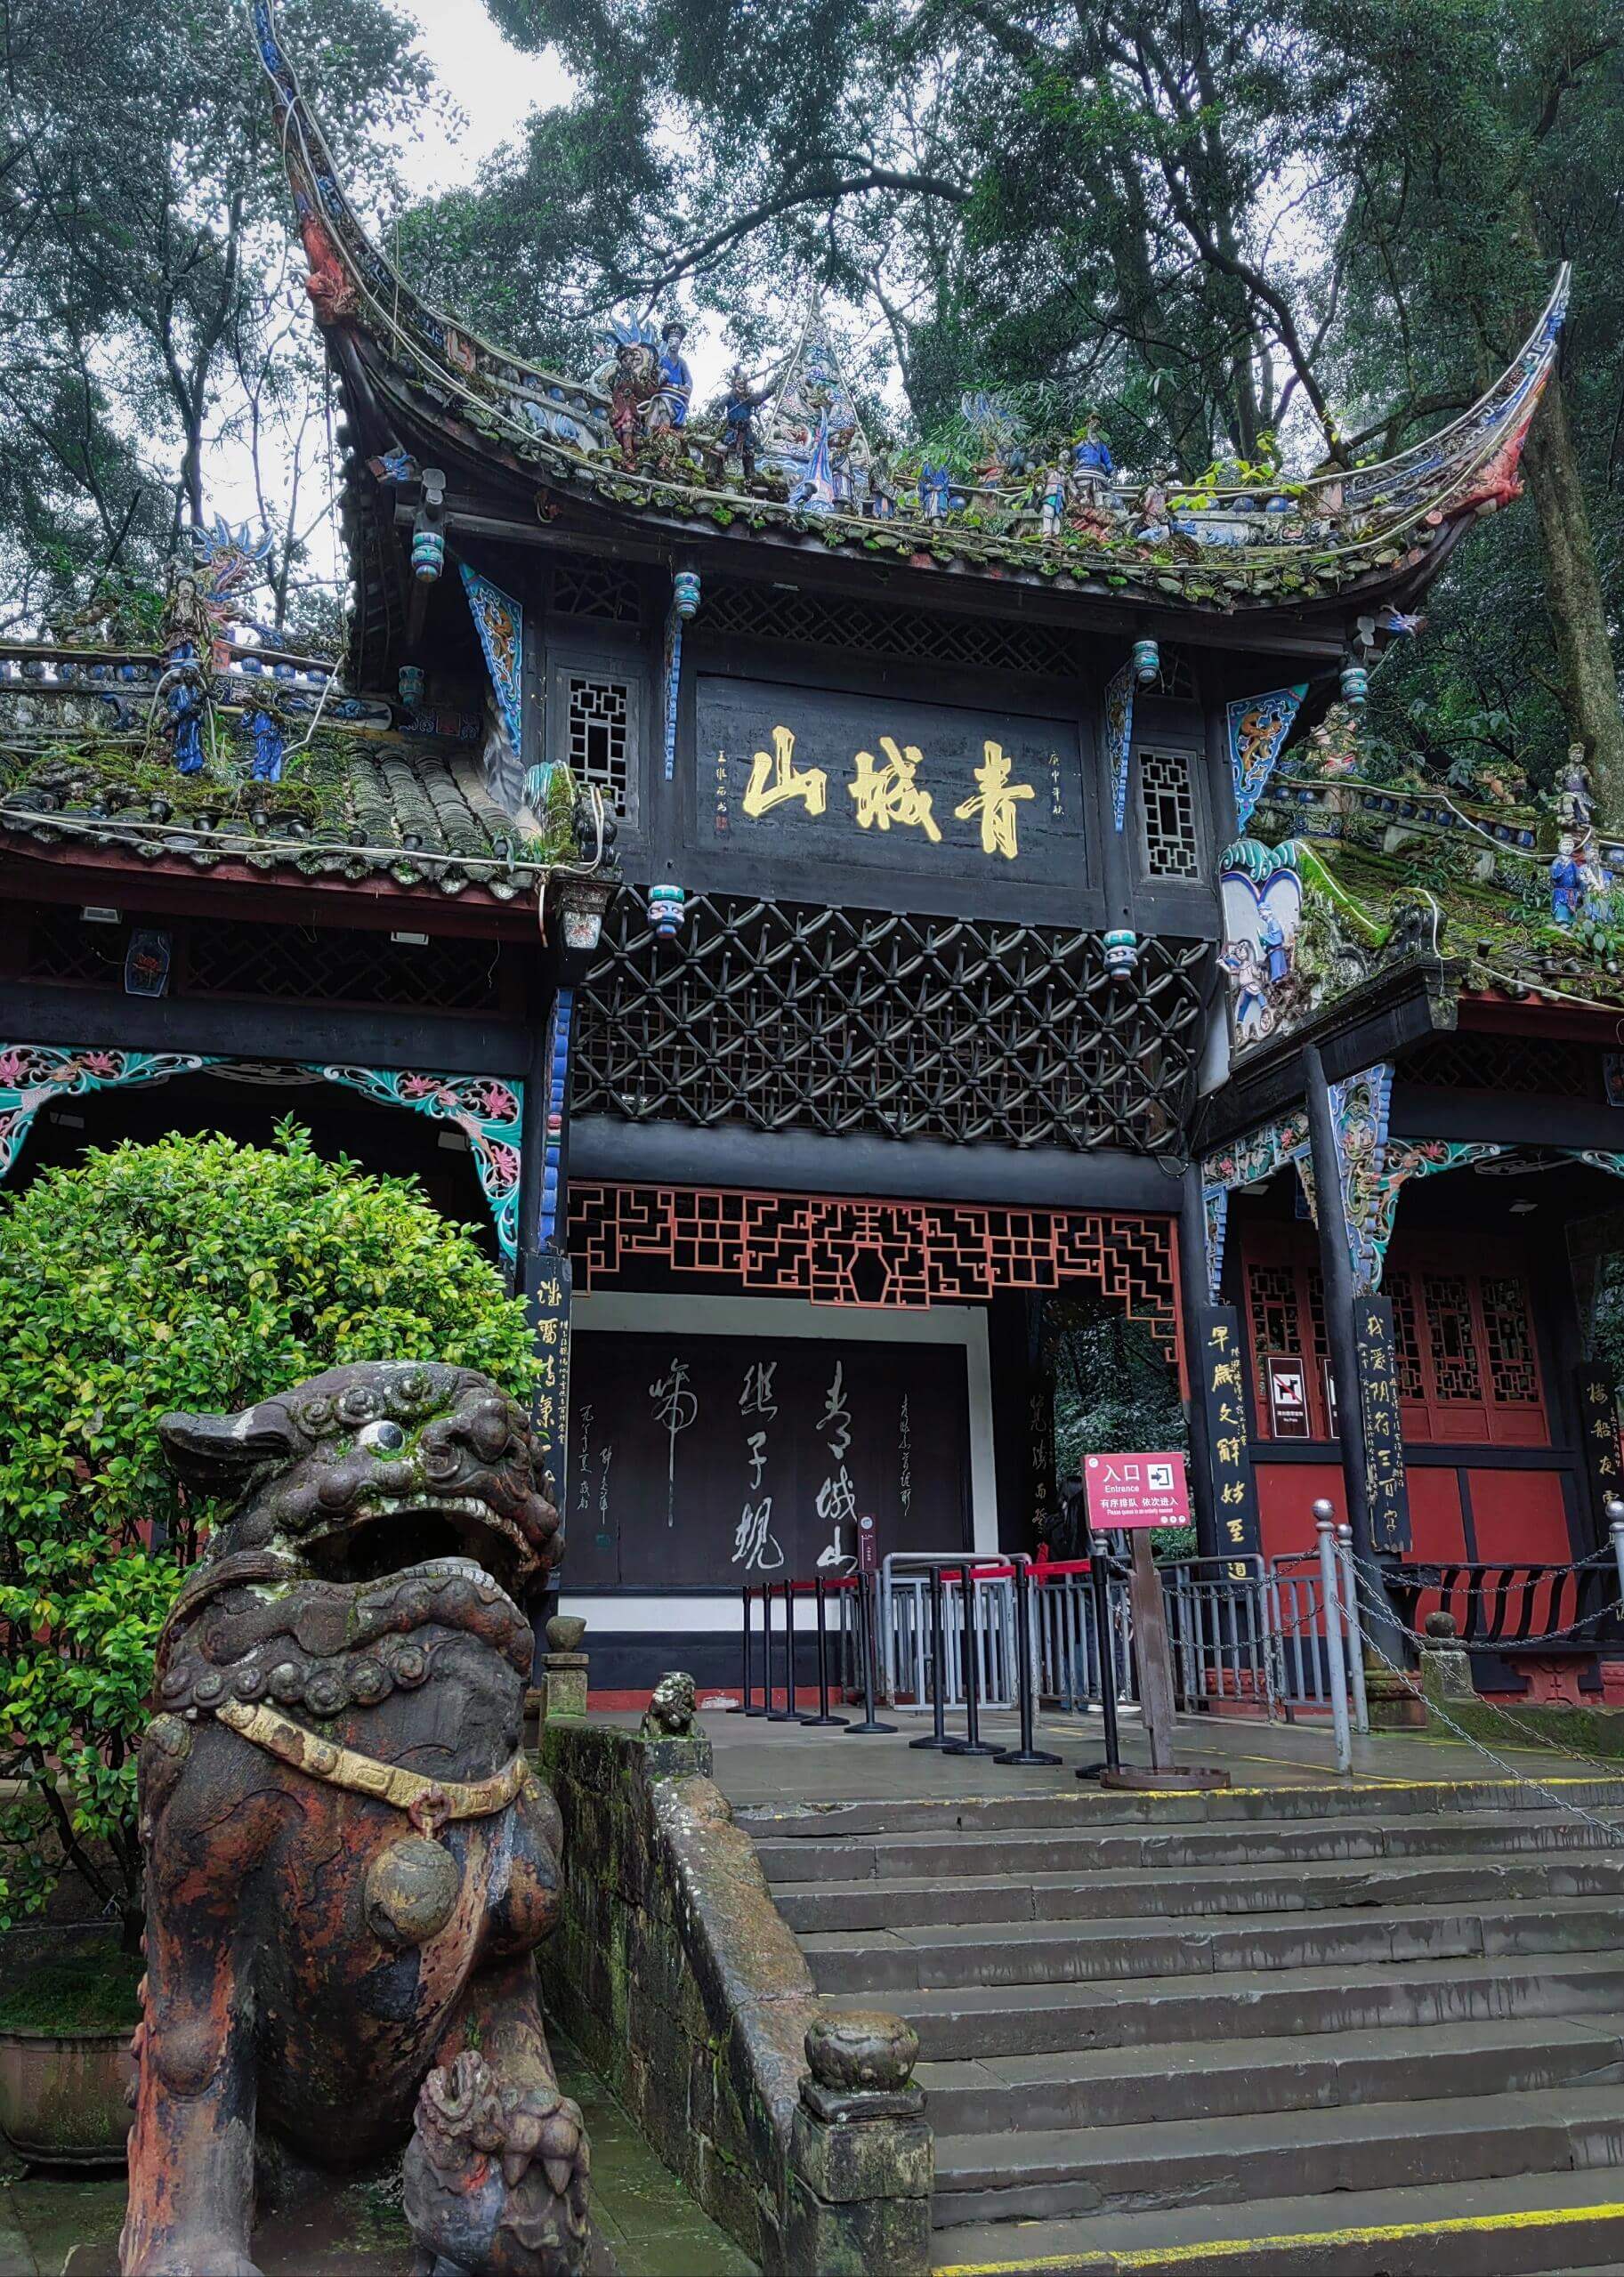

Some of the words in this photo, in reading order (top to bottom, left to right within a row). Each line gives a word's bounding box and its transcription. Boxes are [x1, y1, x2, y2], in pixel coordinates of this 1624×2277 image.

[741, 725, 1035, 860] 青城山
[1103, 1465, 1141, 1482] 入口
[1104, 1484, 1140, 1493] Entrance
[1100, 1498, 1138, 1508] 有序排队
[1142, 1496, 1179, 1507] 依次进入
